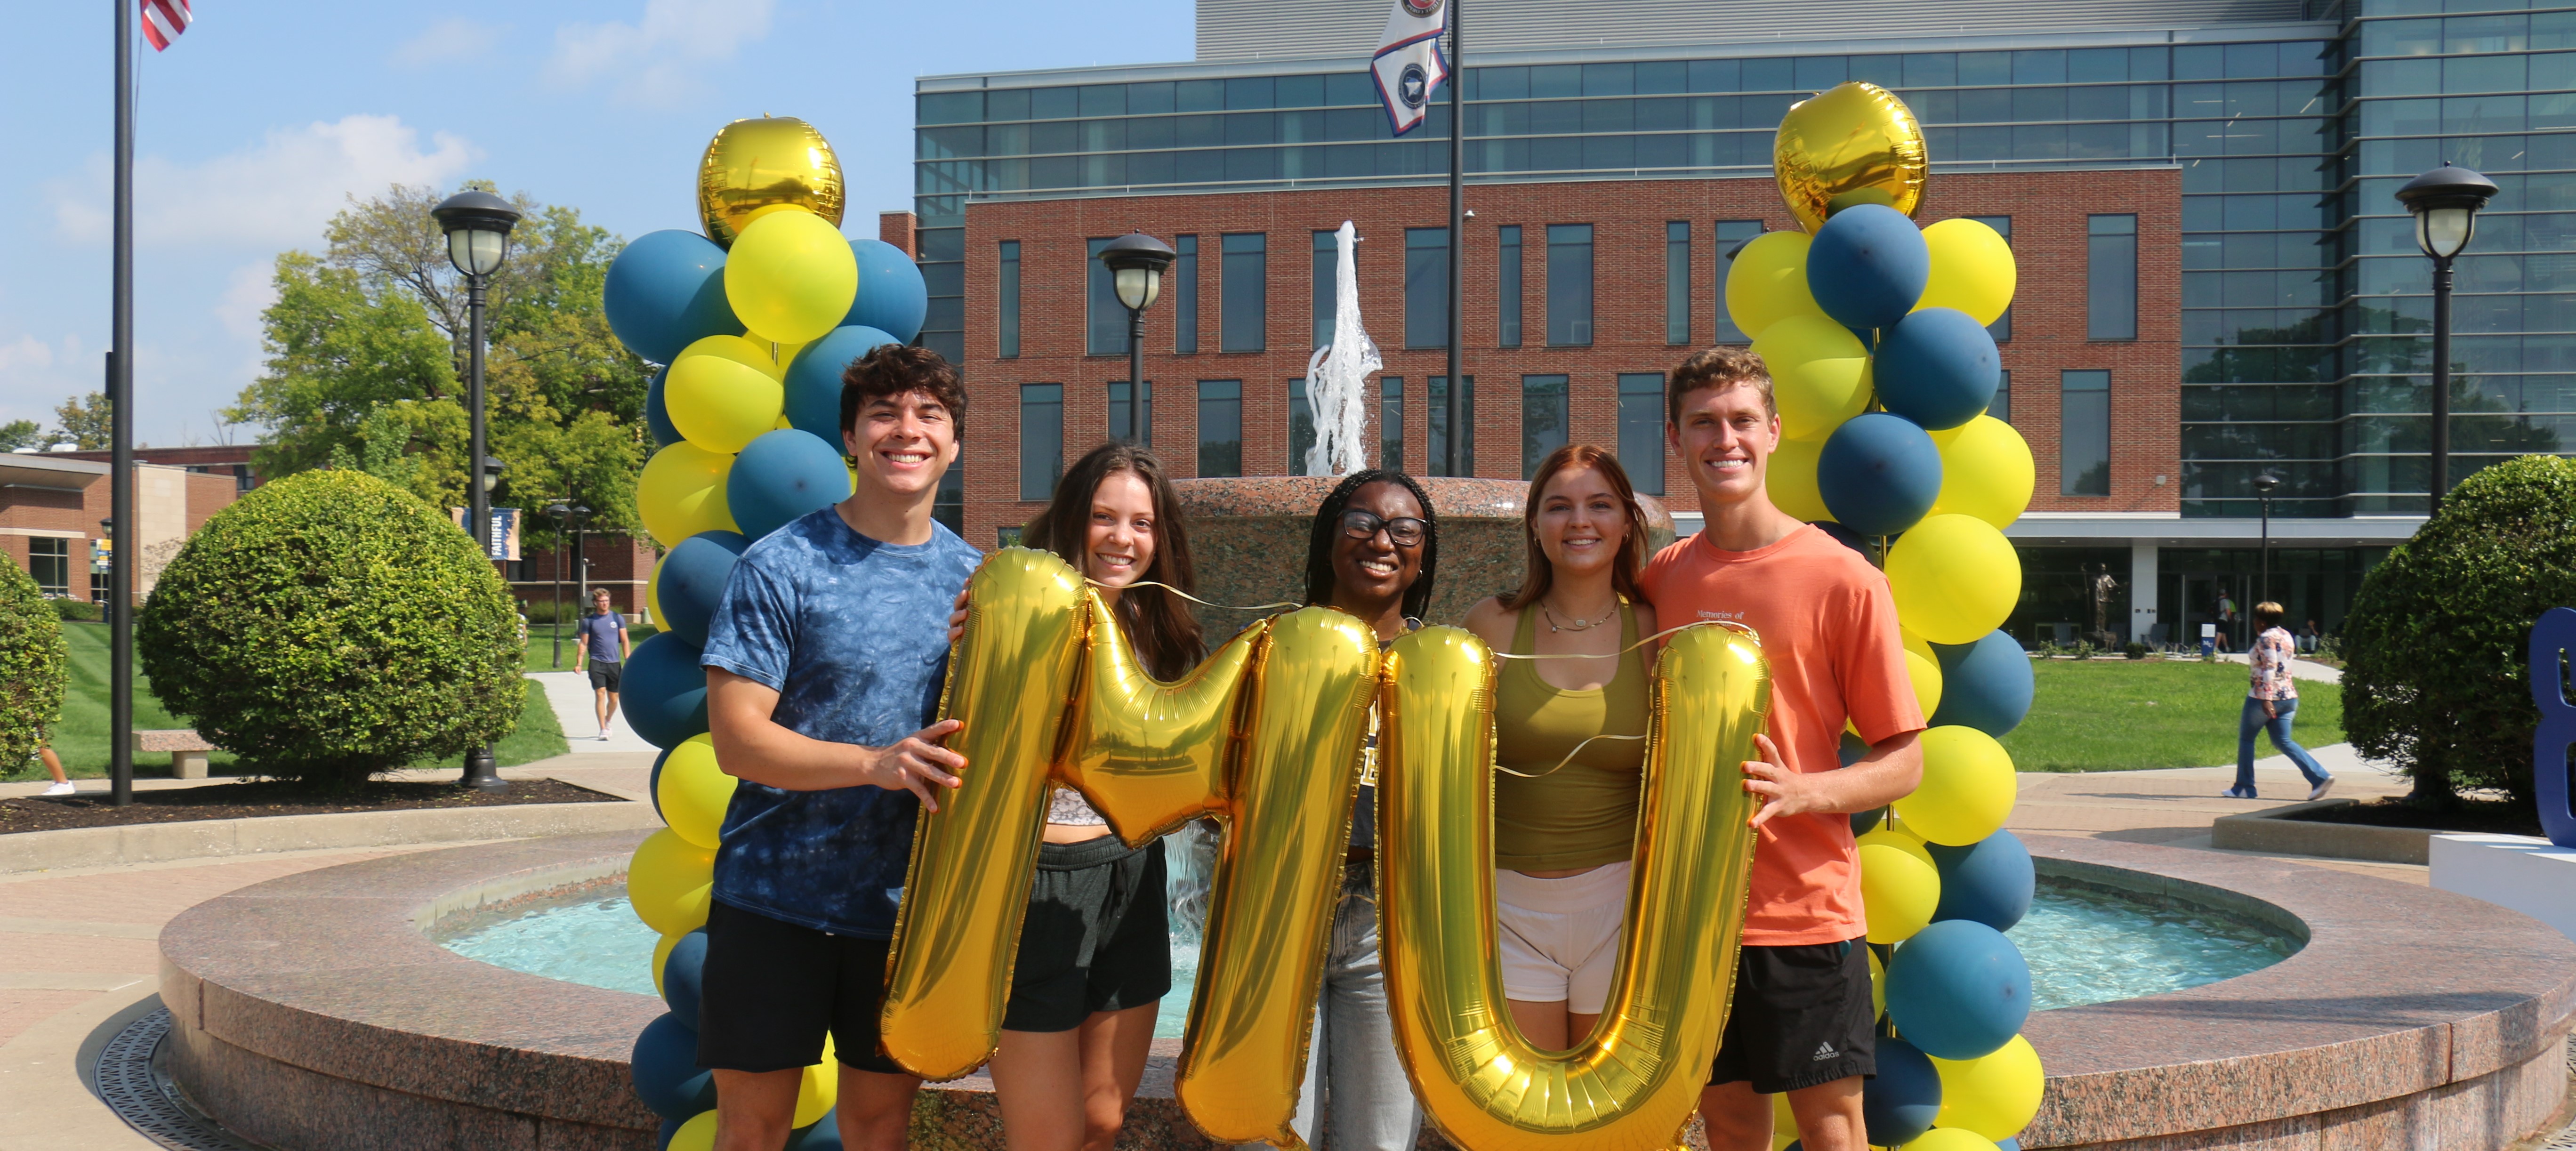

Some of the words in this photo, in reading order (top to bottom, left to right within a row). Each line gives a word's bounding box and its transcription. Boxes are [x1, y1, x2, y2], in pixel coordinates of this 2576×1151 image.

[491, 515, 502, 555] FAITHFUL
[1696, 610, 1732, 619] Memories
[1734, 612, 1744, 620] of
[1813, 1052, 1839, 1061] adidas
